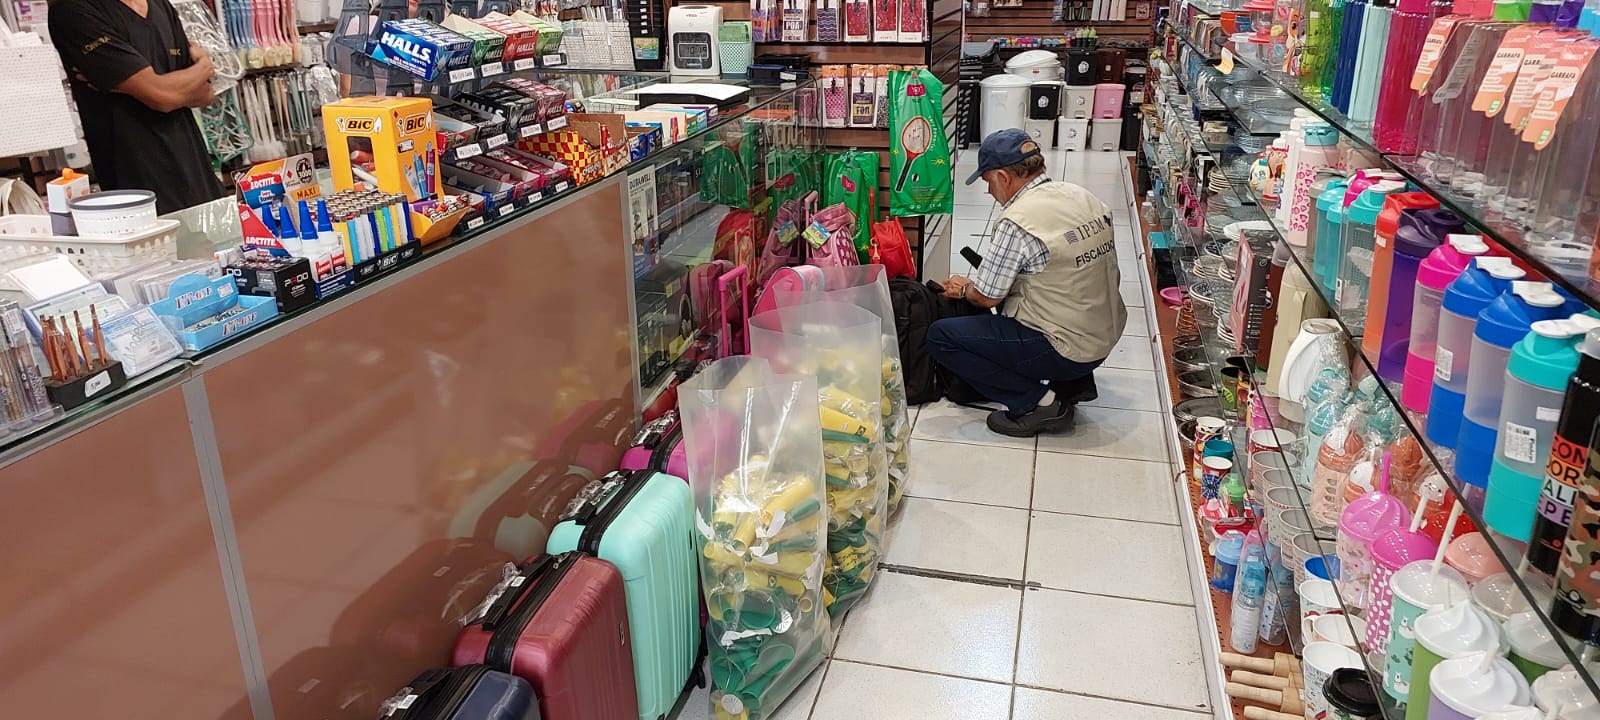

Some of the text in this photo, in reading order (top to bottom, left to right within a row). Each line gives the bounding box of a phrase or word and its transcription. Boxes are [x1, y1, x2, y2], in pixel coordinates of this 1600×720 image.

[381, 31, 432, 64] HALLS
[517, 43, 535, 52] HALLS
[1551, 71, 1576, 79] GARRAFA
[348, 121, 372, 129] BIC
[406, 117, 425, 130] BIC
[250, 177, 275, 189] LOCTITE
[296, 188, 316, 199] MAXI
[1076, 217, 1105, 240] IPEM
[246, 236, 276, 246] LOCTITE
